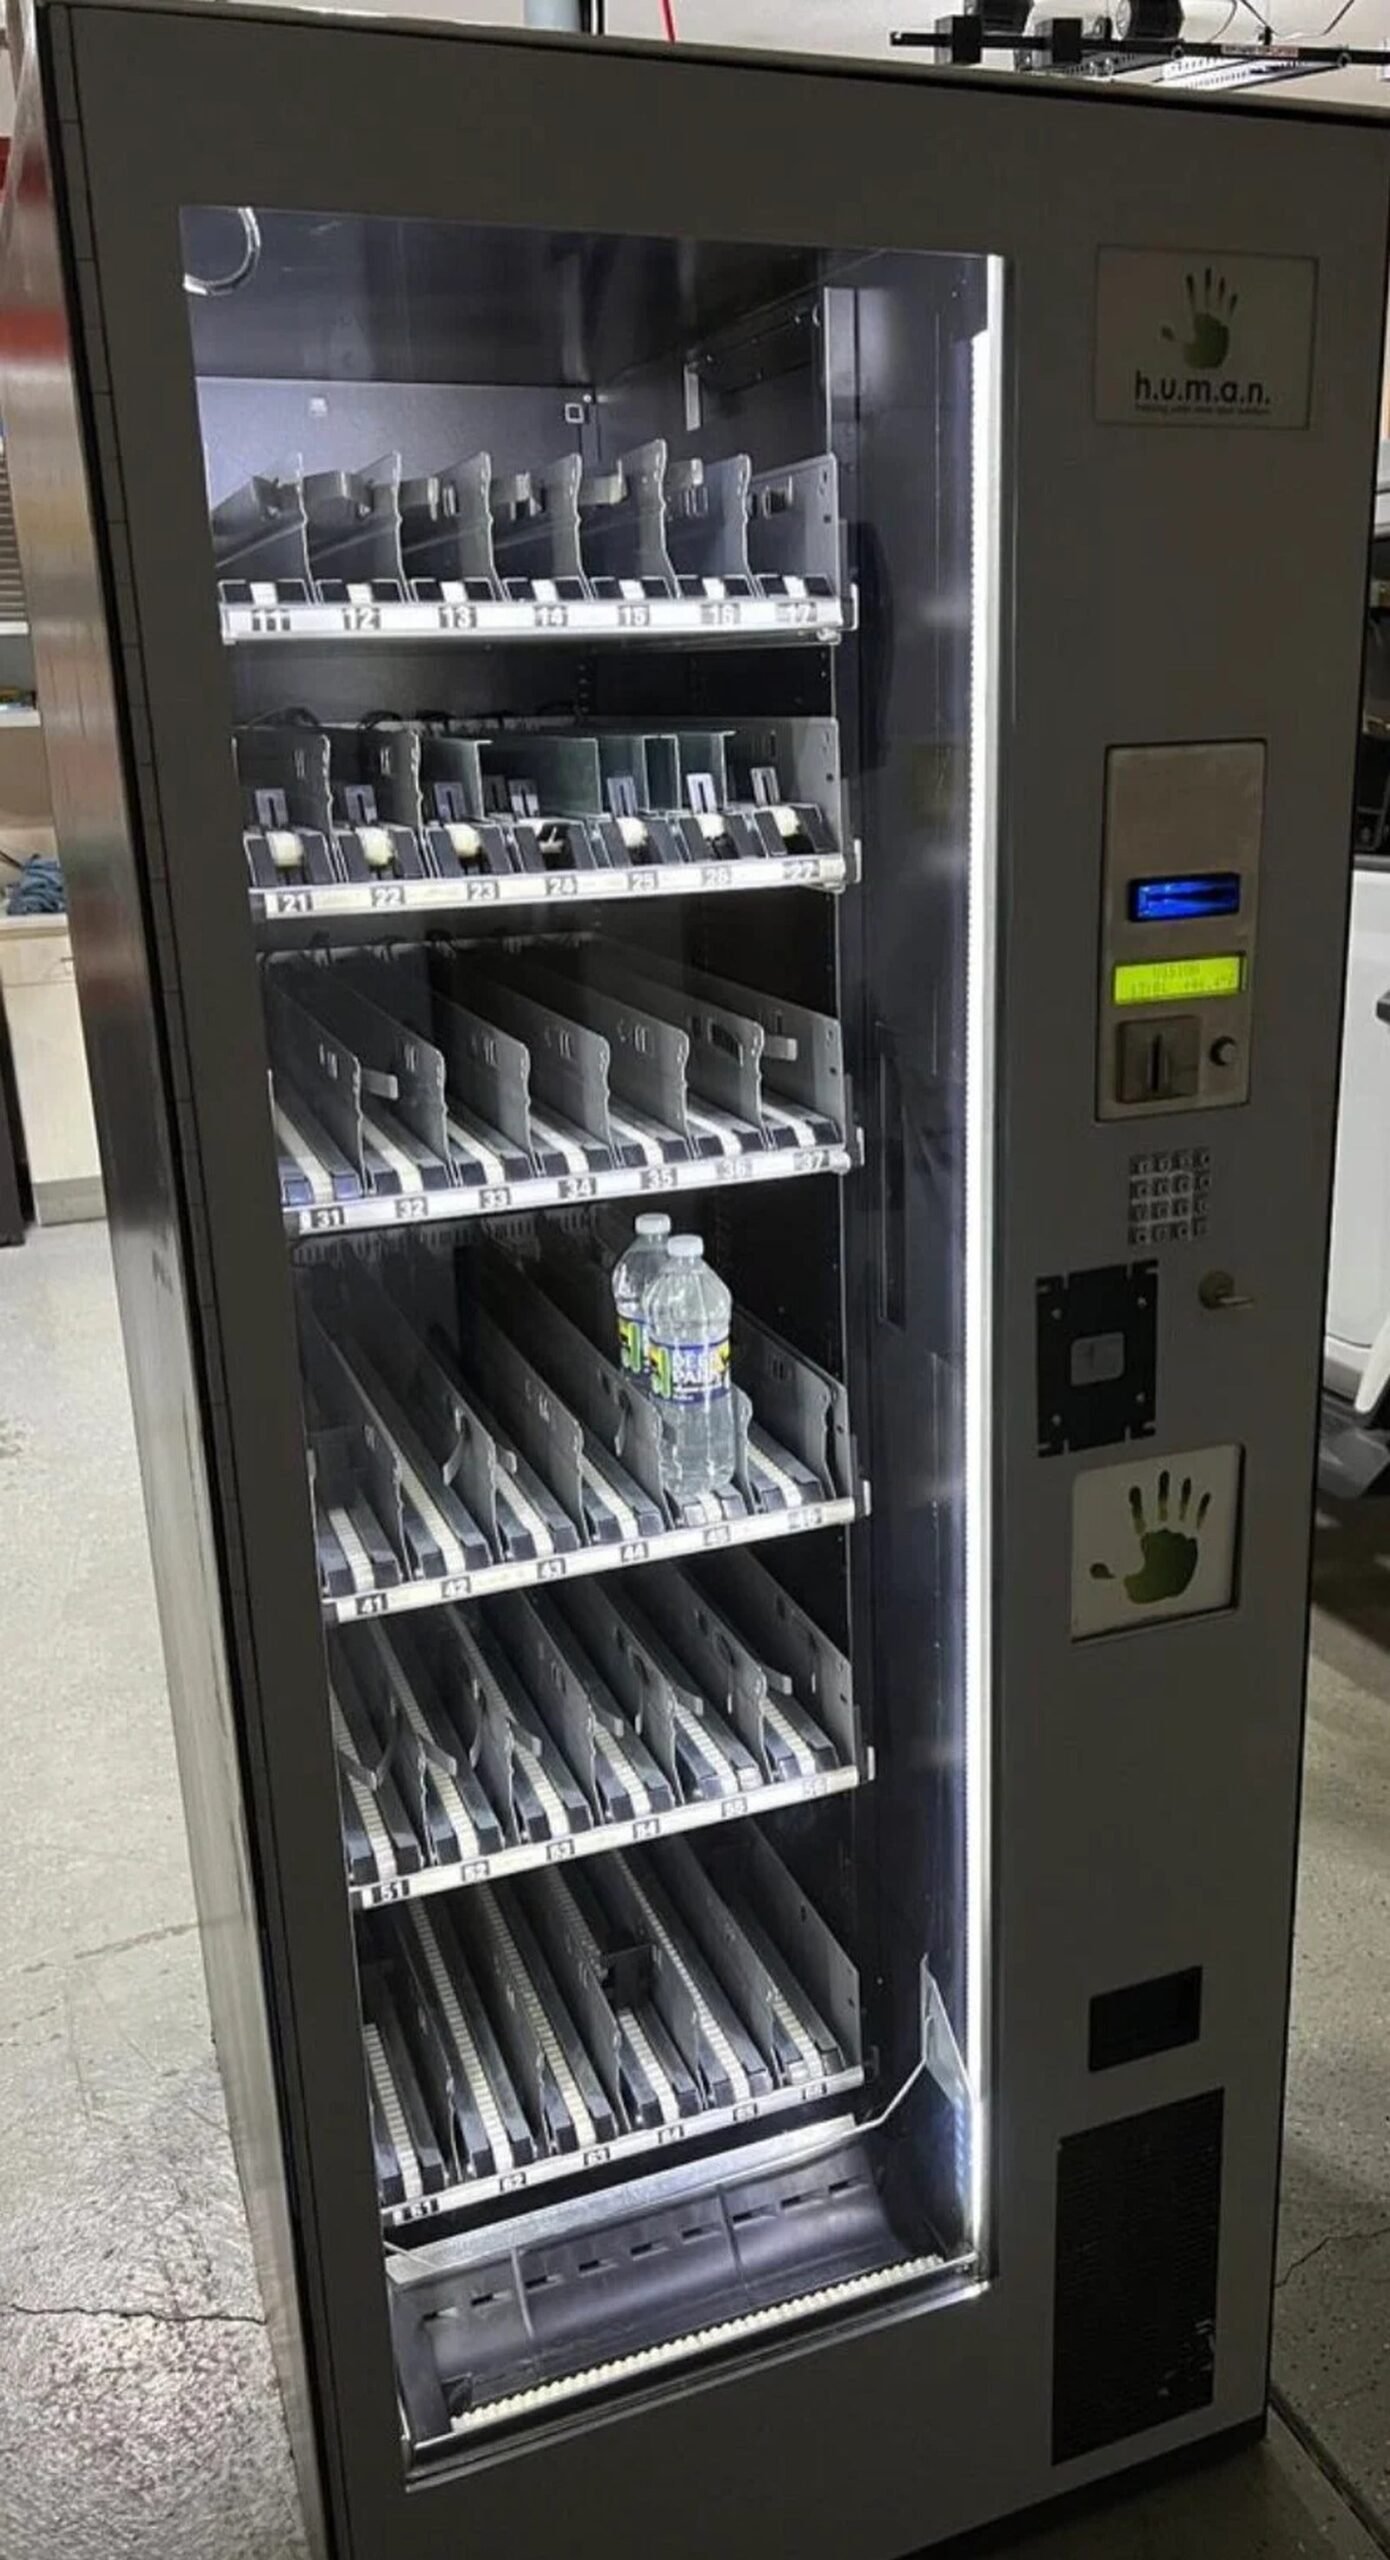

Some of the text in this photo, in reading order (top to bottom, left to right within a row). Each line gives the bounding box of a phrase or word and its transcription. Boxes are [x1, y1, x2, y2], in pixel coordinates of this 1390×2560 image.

[1134, 369, 1271, 405] h.u.m.a.n.
[346, 608, 377, 629] 12
[443, 607, 472, 628] 13
[622, 607, 647, 626] 15
[282, 893, 309, 912] 21
[373, 888, 401, 907] 22
[470, 882, 497, 900] 23
[317, 1151, 824, 1226] 31 32 33 34 35 36 37
[361, 1596, 383, 1614] 41
[445, 1580, 468, 1597] 42
